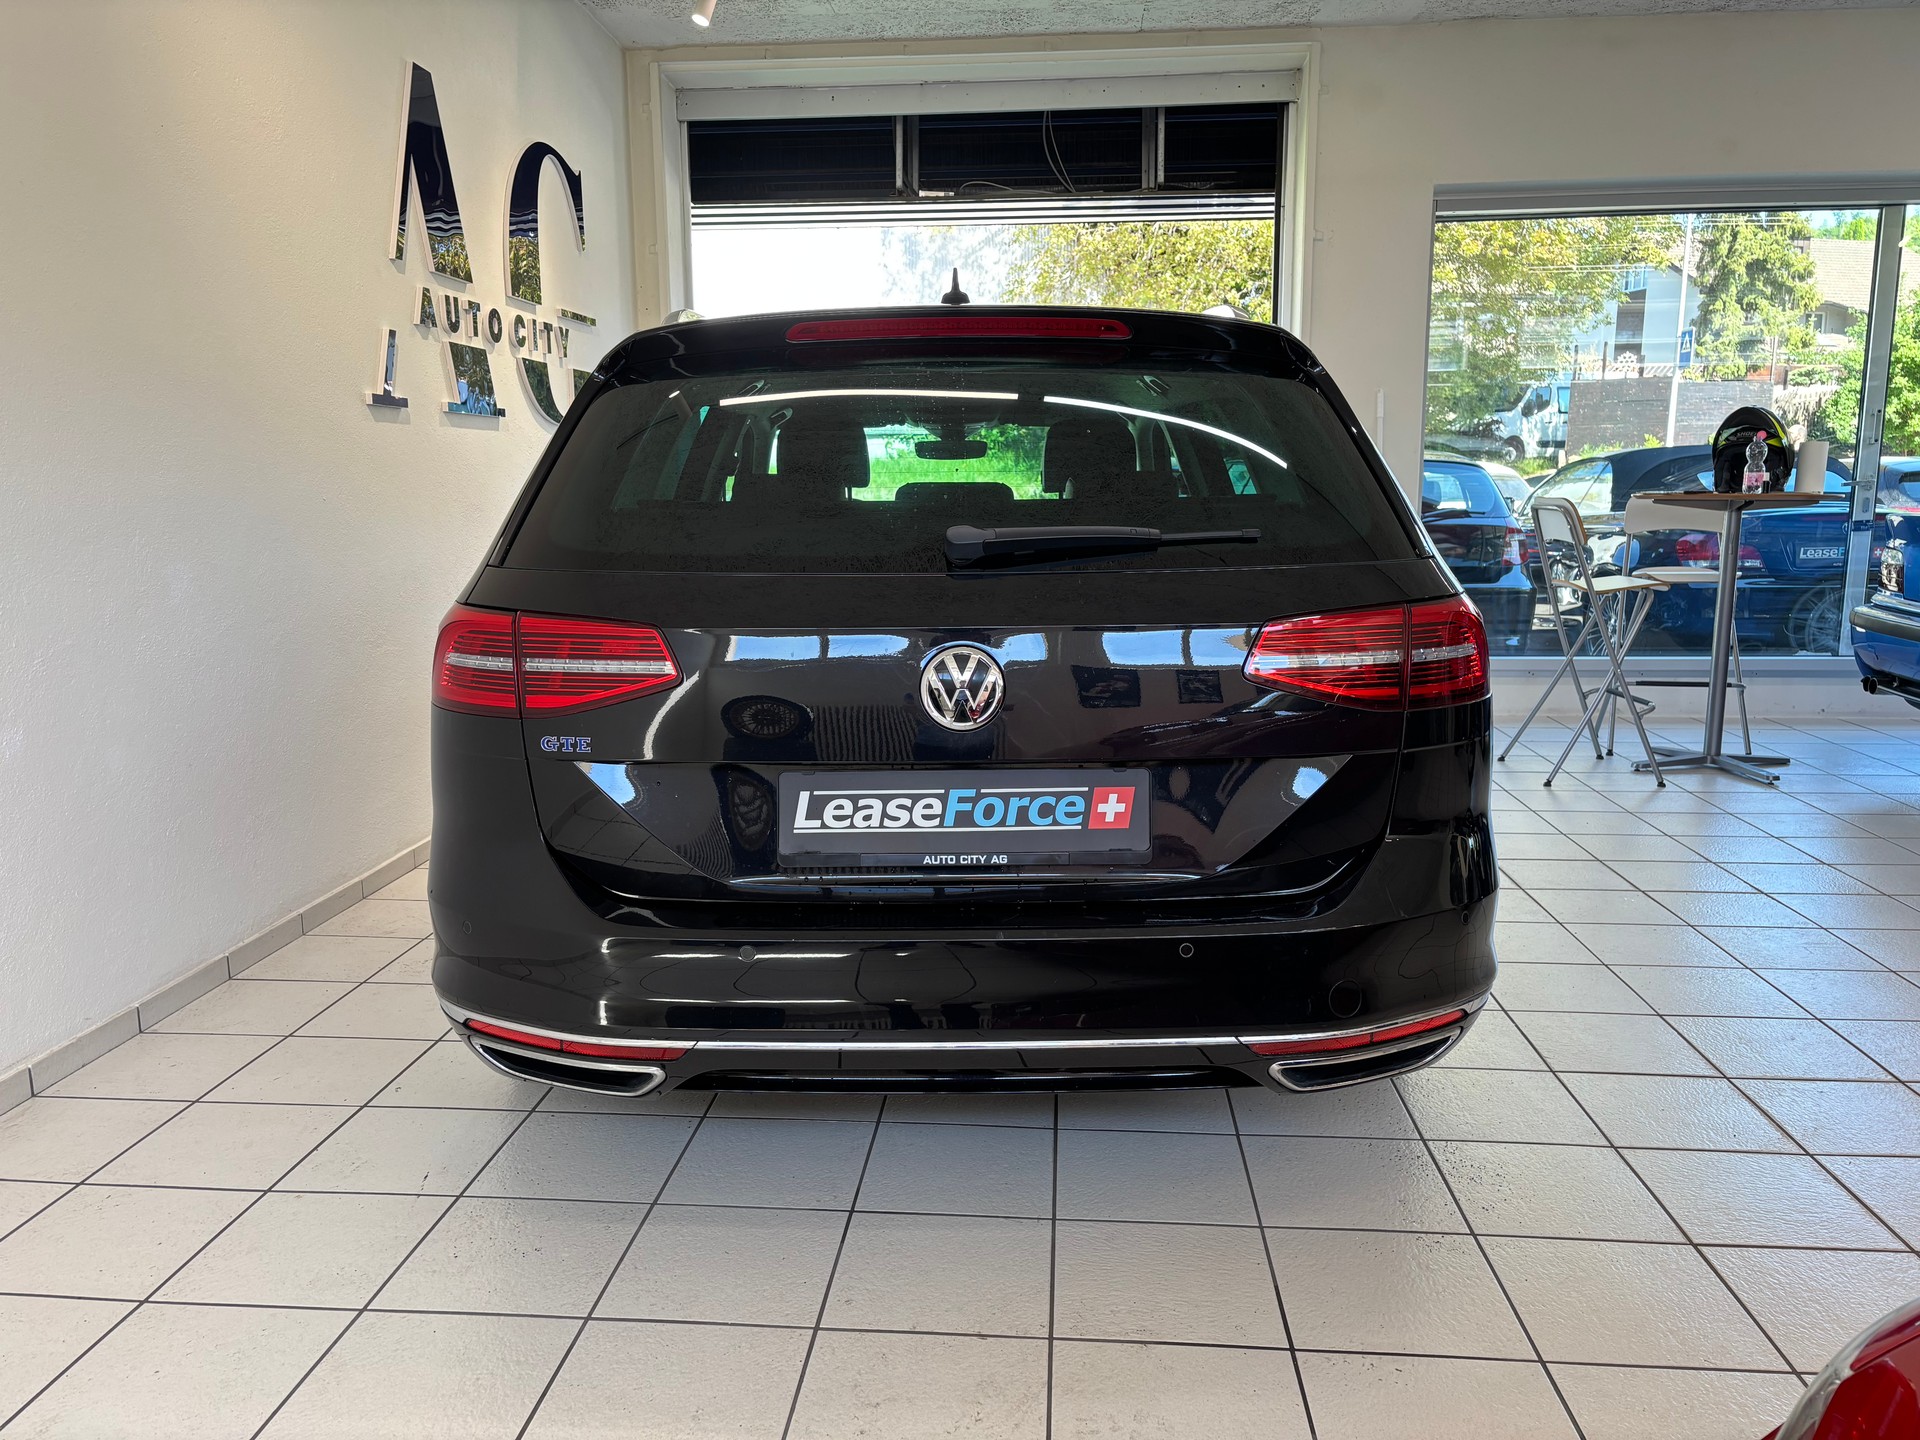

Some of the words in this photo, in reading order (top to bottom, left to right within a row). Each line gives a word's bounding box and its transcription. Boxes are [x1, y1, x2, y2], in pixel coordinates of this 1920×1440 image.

[413, 286, 503, 344] AUTO
[509, 314, 570, 358] CITY
[1800, 547, 1845, 558] LeaseF
[540, 735, 592, 752] GTE
[793, 788, 1086, 829] LeaseForce
[923, 855, 956, 865] AUTO
[960, 854, 987, 865] CITY
[990, 854, 1008, 864] AG
